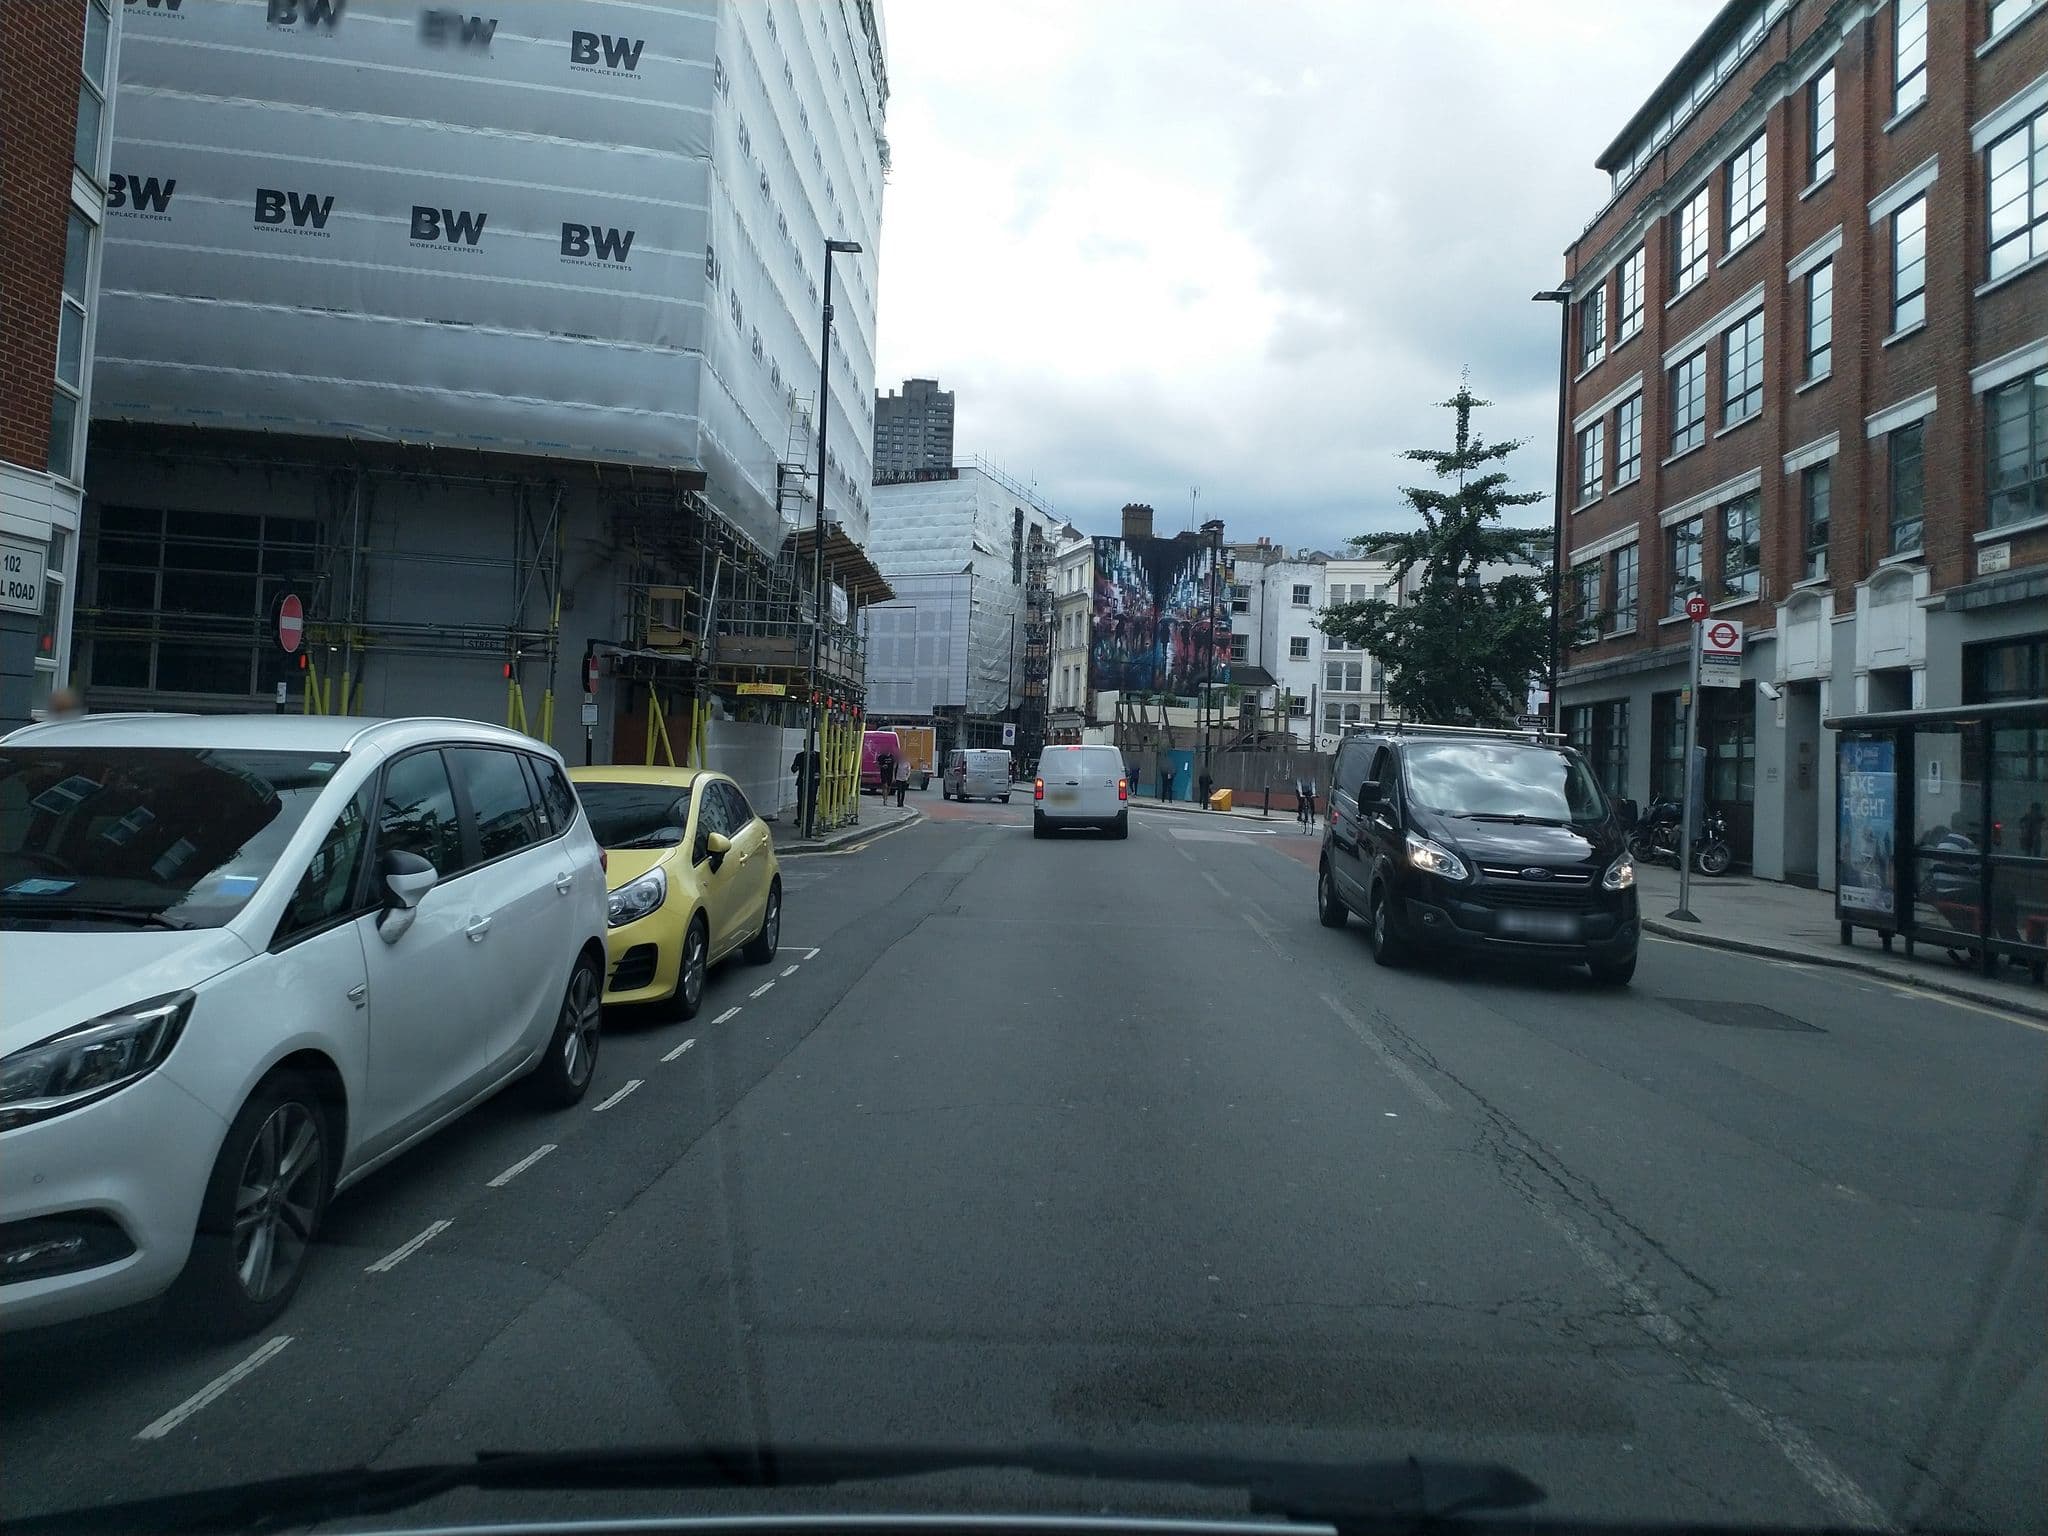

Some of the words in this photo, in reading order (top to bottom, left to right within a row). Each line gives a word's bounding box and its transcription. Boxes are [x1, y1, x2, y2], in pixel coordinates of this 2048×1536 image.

[153, 11, 185, 20] EXPERTS
[571, 30, 645, 71] BW
[570, 65, 611, 76] WORKPLACE
[612, 71, 642, 80] EXPERTS
[107, 173, 176, 213] BW
[140, 214, 172, 222] EXPERTS
[254, 188, 335, 229] BW
[253, 225, 298, 235] WORKPLACE
[299, 230, 331, 239] EXPERTS
[410, 205, 488, 246] BW
[409, 241, 451, 251] WORKPLACE
[453, 246, 485, 255] EXPERTS
[560, 222, 636, 263] BW
[560, 258, 602, 268] WORKPLACE
[602, 263, 633, 272] EXPERTS
[4, 554, 21, 573] 102
[9, 582, 35, 601] ROAD
[1690, 603, 1705, 613] BT
[1842, 775, 1875, 795] TAKE
[1842, 798, 1886, 817] FLIGHT
